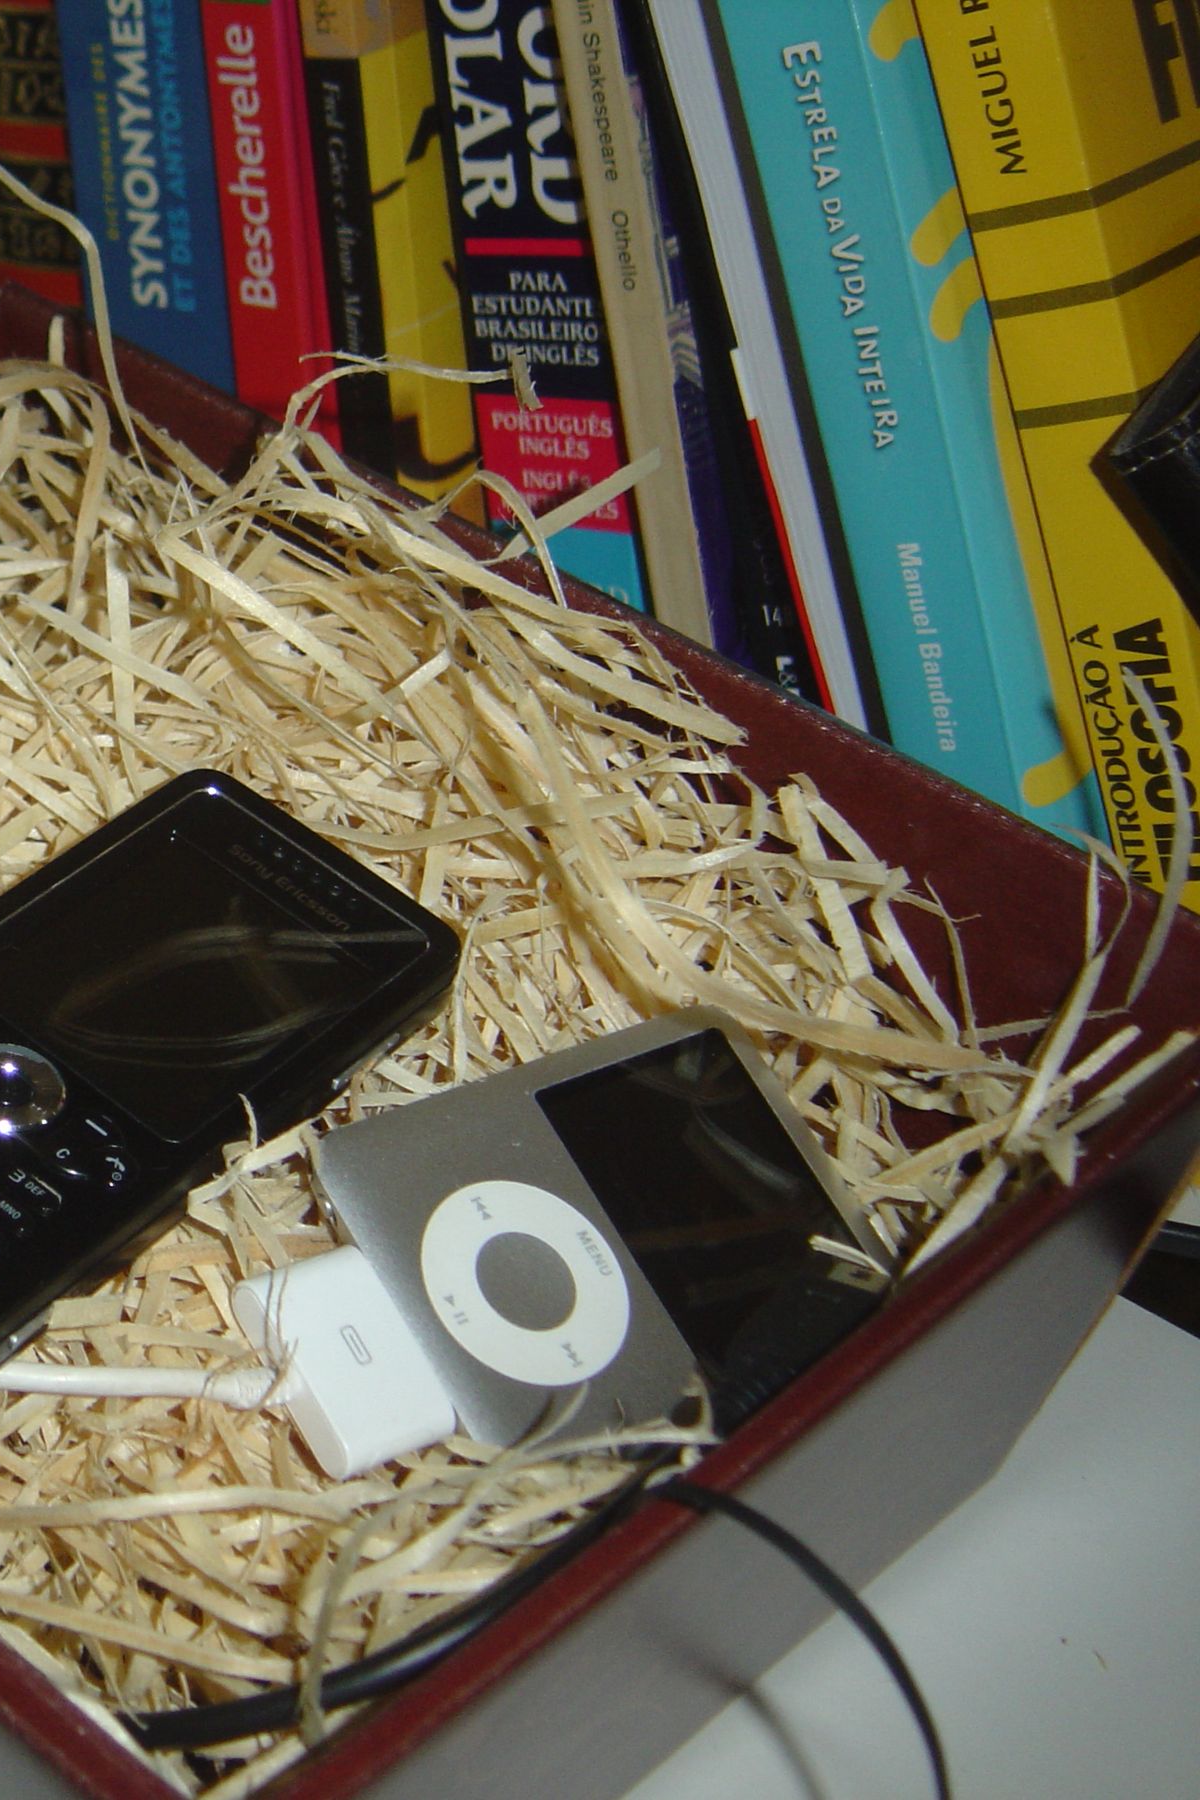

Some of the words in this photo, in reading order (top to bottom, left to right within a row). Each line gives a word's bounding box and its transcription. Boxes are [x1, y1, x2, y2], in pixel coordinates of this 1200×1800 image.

[437, 0, 518, 220] OLAR
[968, 25, 1028, 175] MIGUEL
[107, 0, 168, 308] SYNONYMES
[216, 24, 278, 310] Bescherelle
[583, 33, 618, 182] Shakespeare
[611, 210, 635, 292] Othello
[166, 209, 193, 266] DES
[782, 40, 841, 190] ESTRELA
[831, 234, 866, 318] VIDA
[853, 325, 899, 450] INTEIRA
[170, 273, 196, 312] ET
[509, 270, 568, 293] PARA
[475, 318, 598, 342] BRASILEIRO
[525, 345, 600, 368] INGLÊS
[492, 411, 613, 438] PORTUGUÊS
[519, 436, 590, 460] INGLÊS
[763, 605, 781, 626] 14
[1069, 623, 1106, 650] À
[896, 542, 937, 636] Manuel
[918, 642, 957, 753] Bandeira
[1081, 659, 1153, 884] INTRODUÇÃO
[8, 1169, 26, 1183] 3
[24, 1178, 46, 1196] DEF
[576, 1229, 613, 1277] MENU
